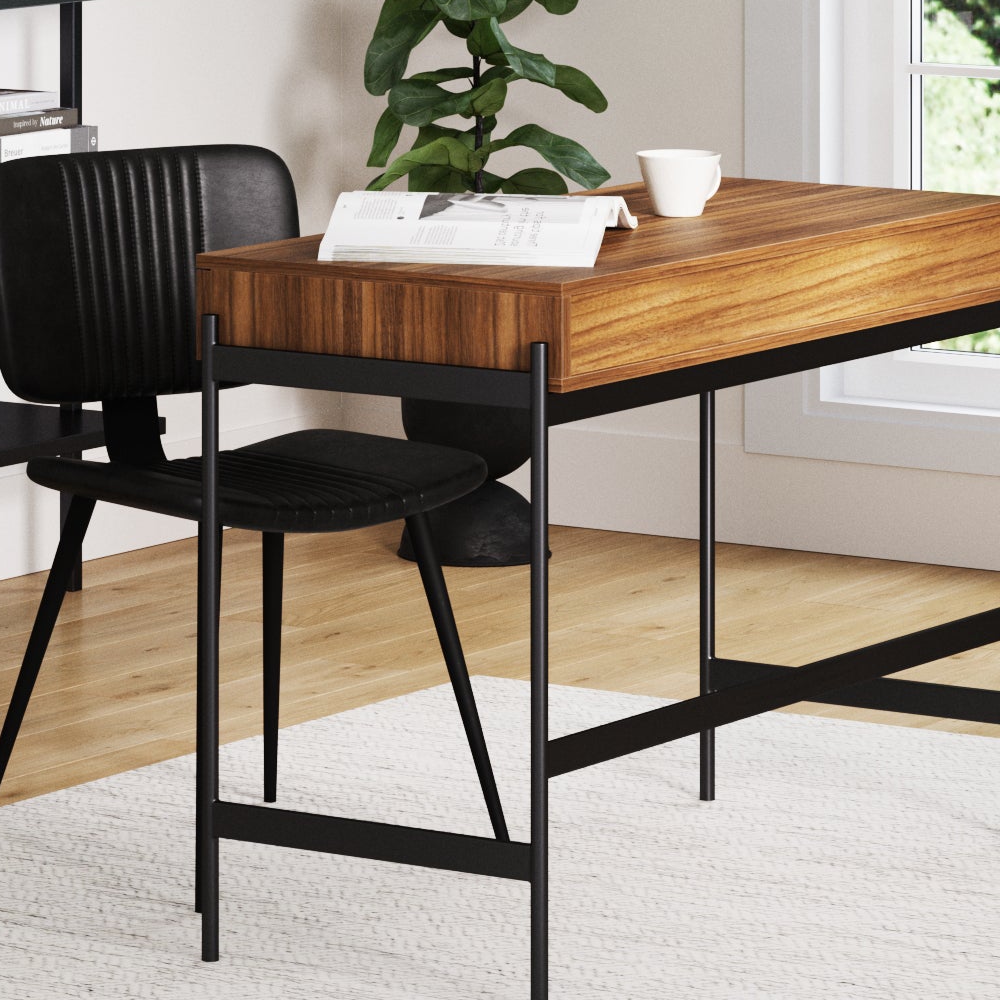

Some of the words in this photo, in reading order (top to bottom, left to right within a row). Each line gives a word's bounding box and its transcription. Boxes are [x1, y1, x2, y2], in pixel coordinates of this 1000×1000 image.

[13, 119, 31, 131] Inspired
[32, 118, 38, 128] by
[39, 115, 64, 127] Nature
[4, 147, 24, 157] Breuer
